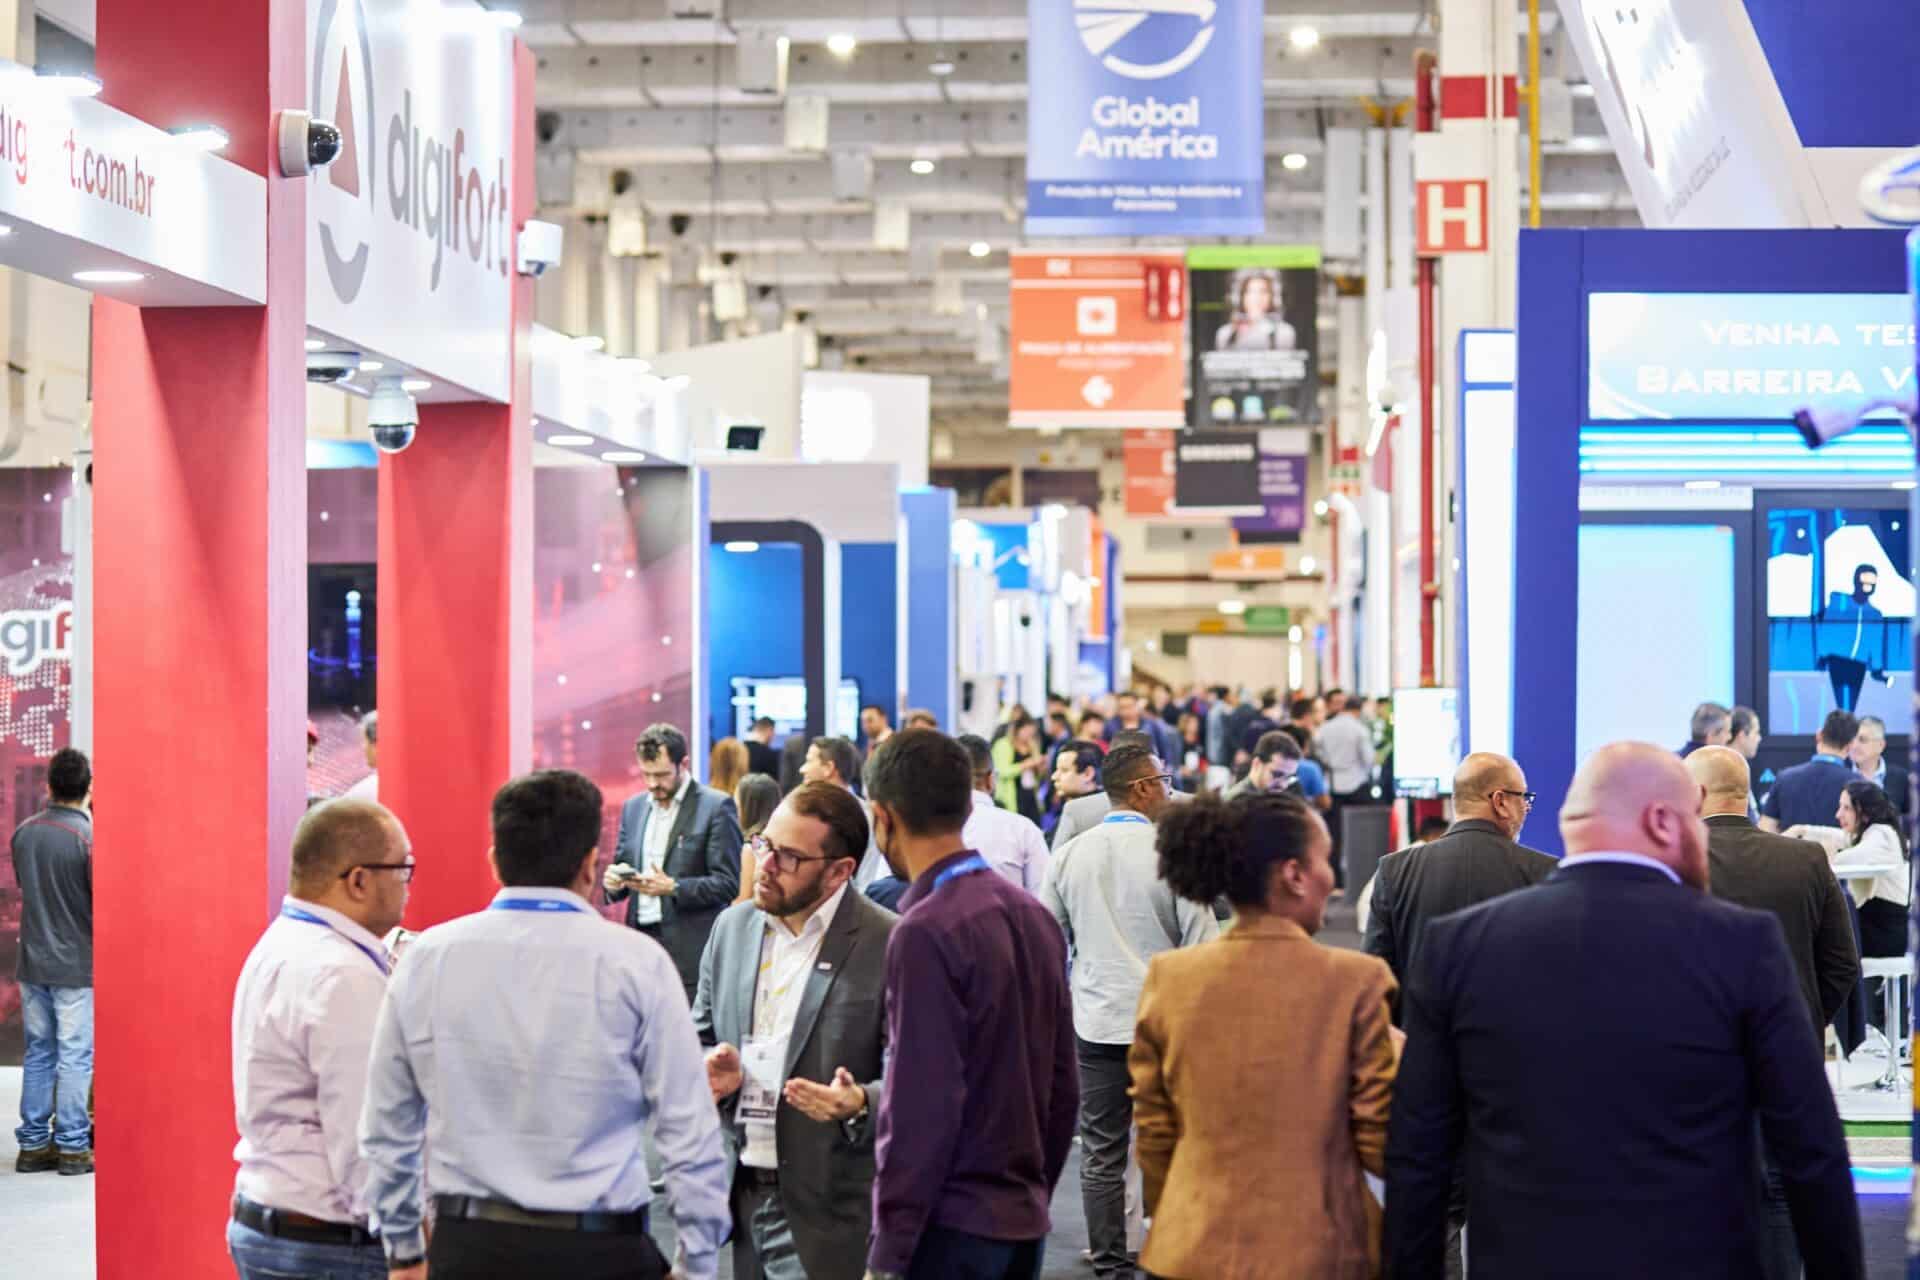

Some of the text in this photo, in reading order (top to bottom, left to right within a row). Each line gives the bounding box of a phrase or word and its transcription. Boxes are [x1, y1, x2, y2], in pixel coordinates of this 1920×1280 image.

[1092, 95, 1200, 127] Global
[1076, 127, 1219, 159] América
[387, 88, 508, 293] digifort
[1427, 183, 1482, 248] H
[1701, 319, 1842, 346] VENHA
[1636, 364, 1865, 395] BARREIRA
